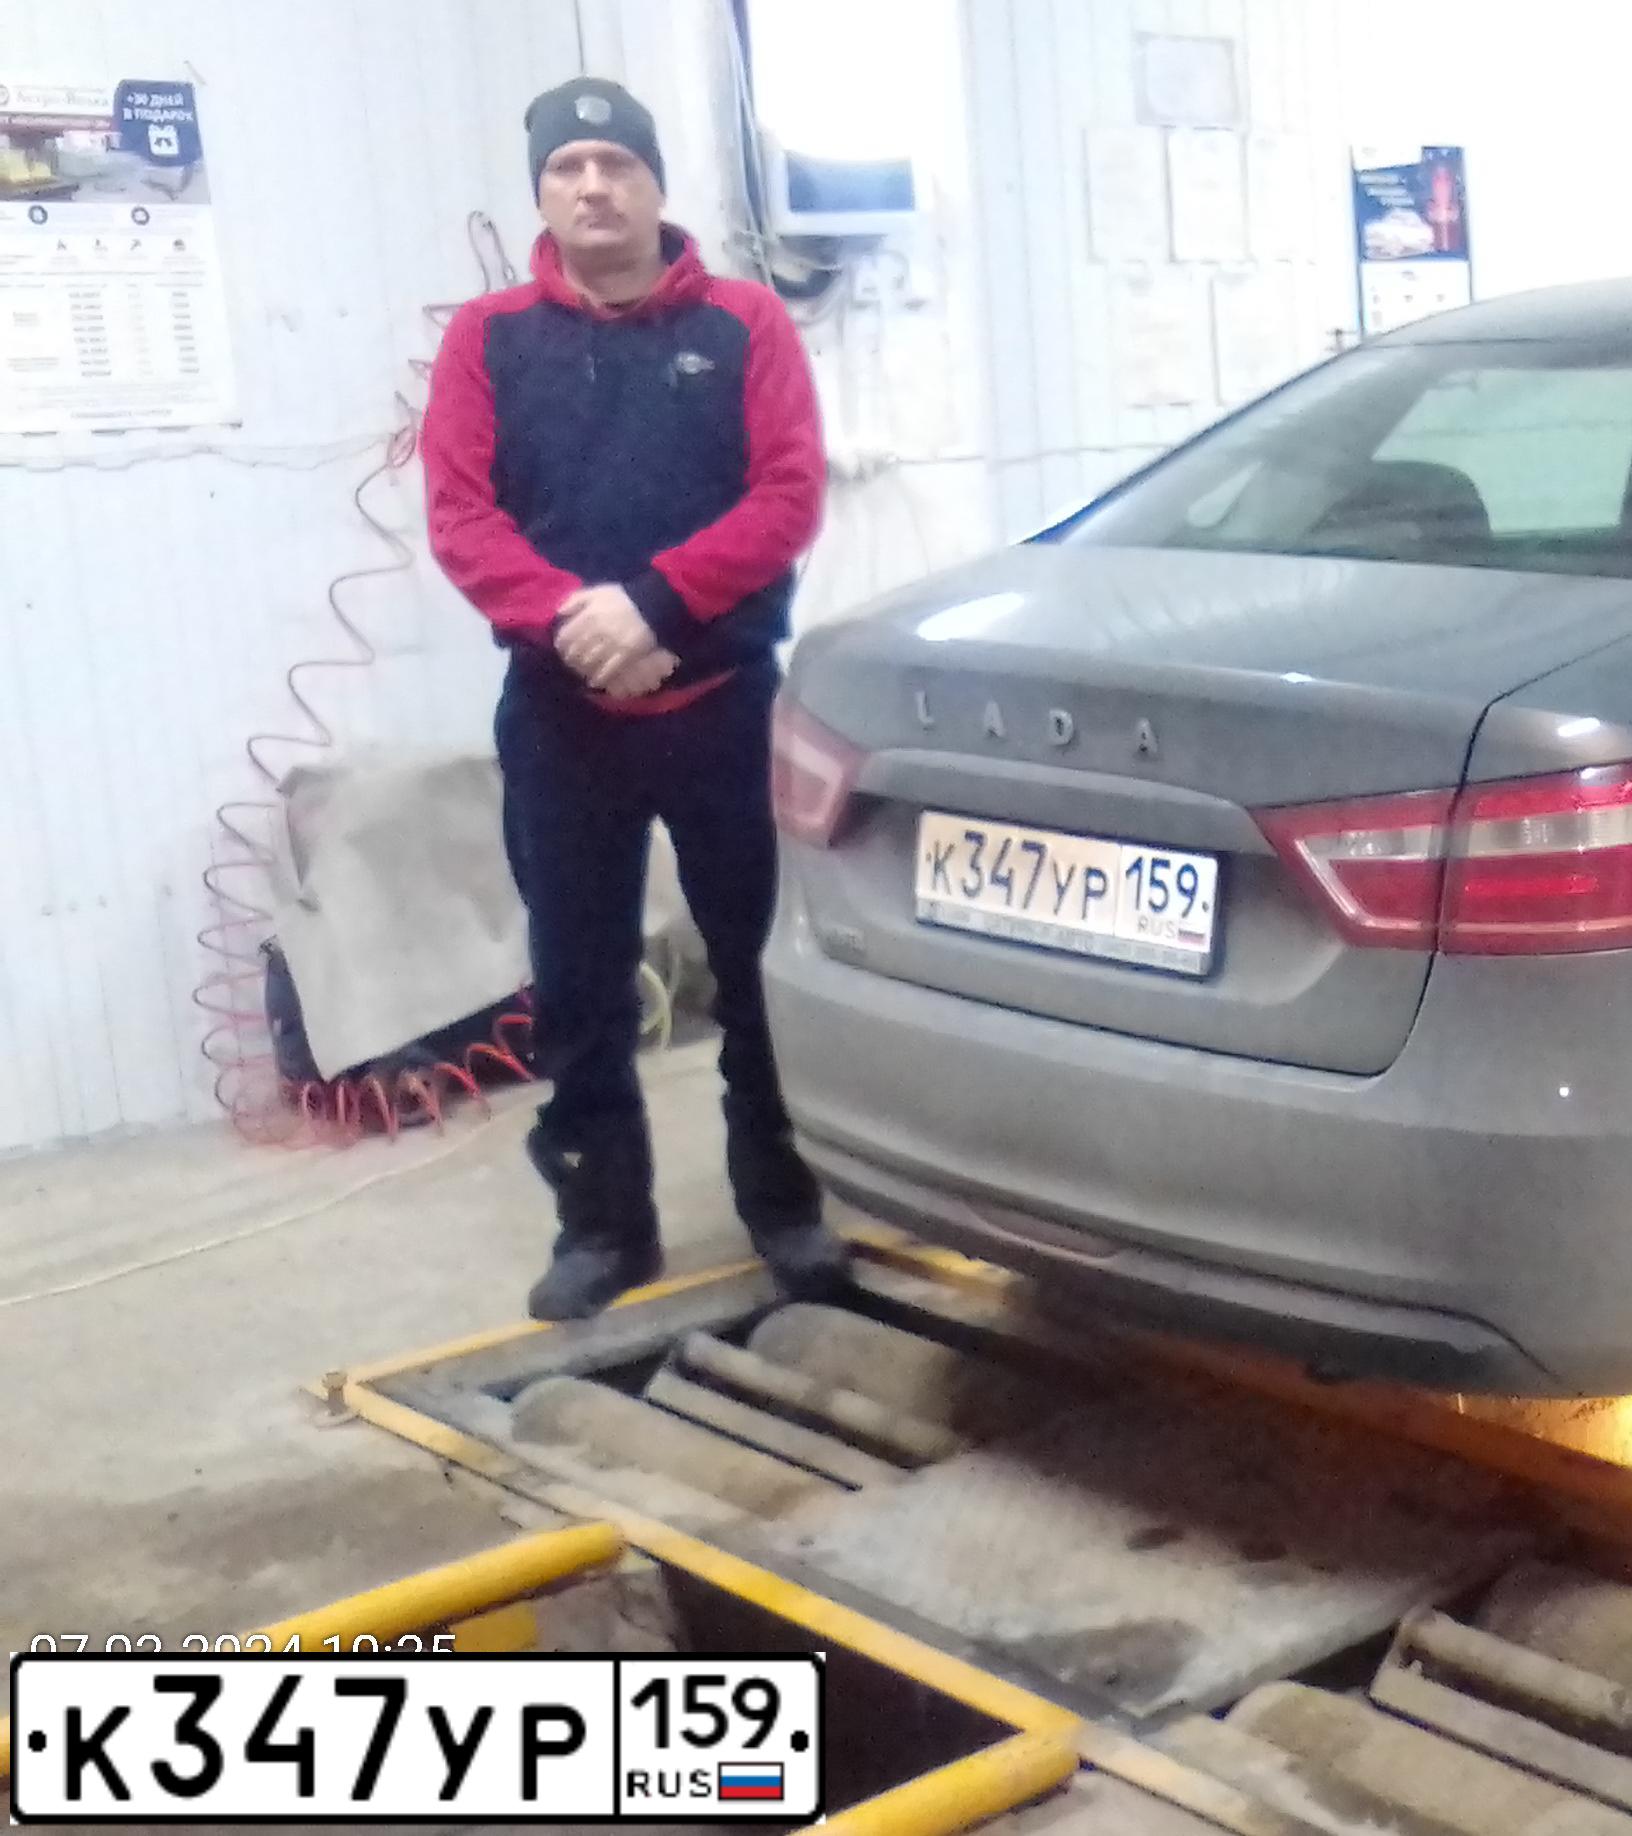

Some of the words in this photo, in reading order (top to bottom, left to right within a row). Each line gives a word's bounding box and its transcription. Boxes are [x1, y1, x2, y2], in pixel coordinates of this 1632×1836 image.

[914, 689, 1159, 755] LADA
[1125, 855, 1199, 918] 159
[1136, 916, 1177, 939] RUS
